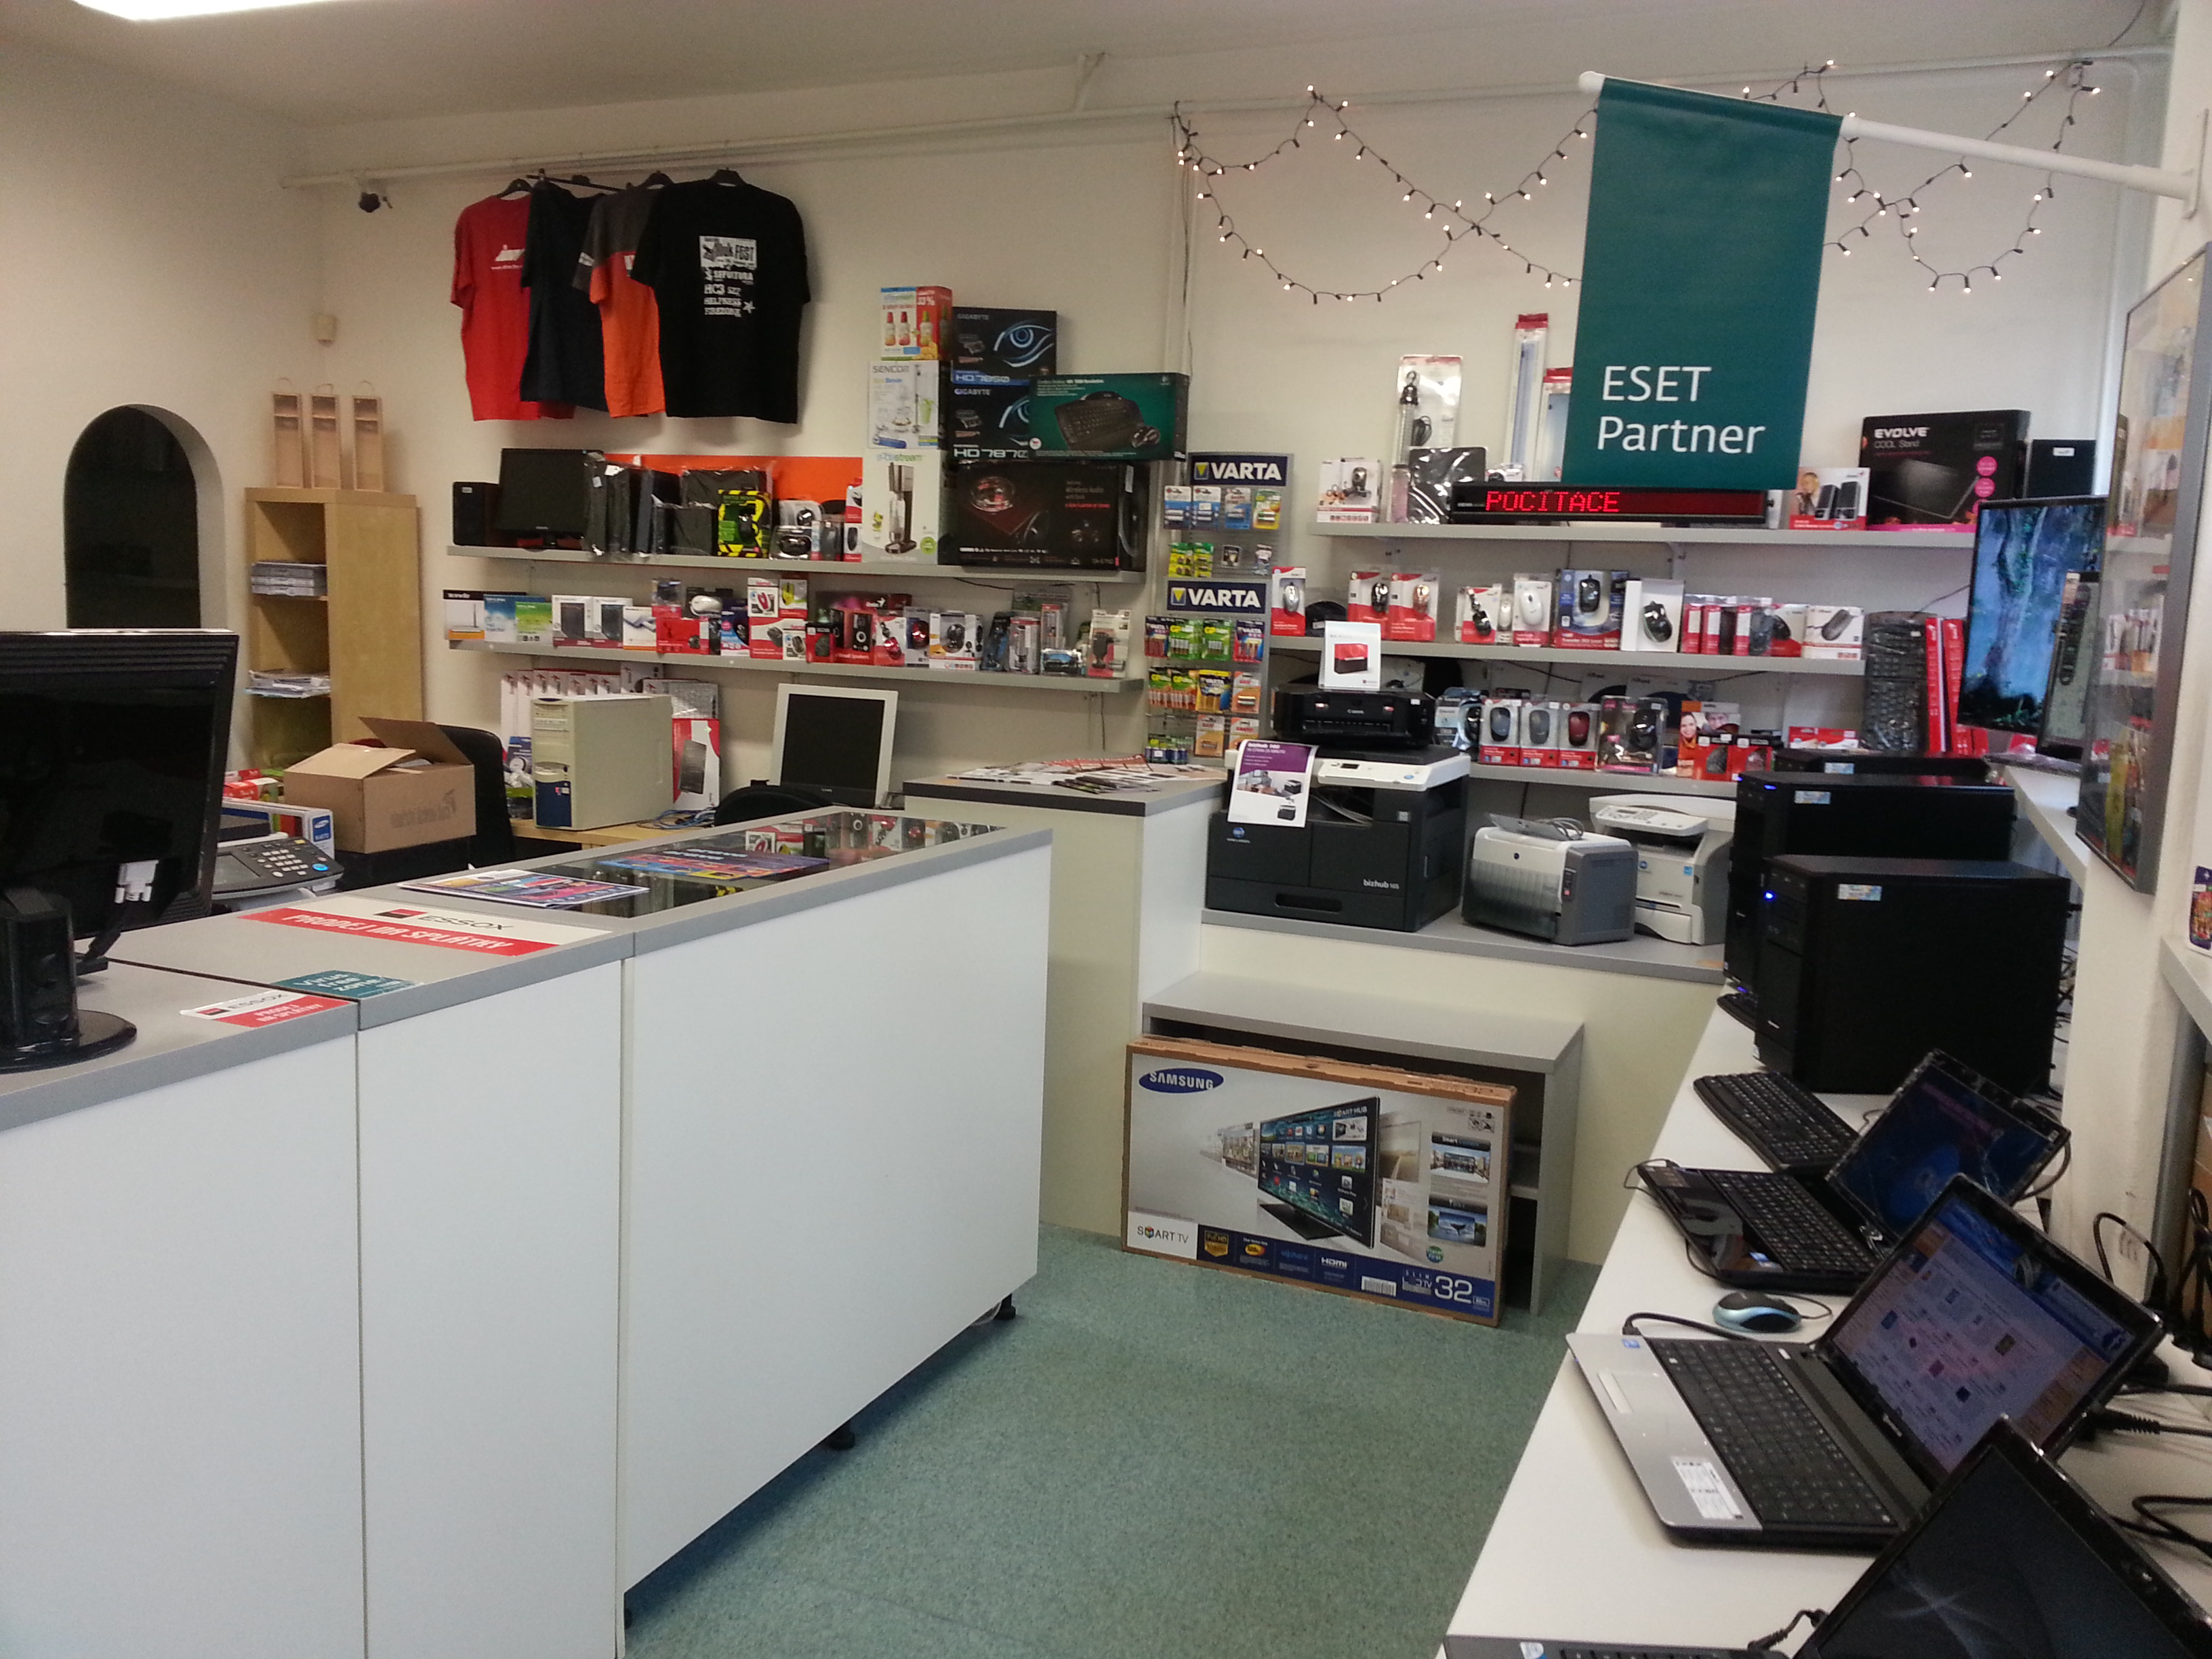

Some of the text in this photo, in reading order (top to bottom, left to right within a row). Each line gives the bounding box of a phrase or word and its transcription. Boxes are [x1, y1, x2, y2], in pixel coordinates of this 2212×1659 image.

[873, 365, 910, 373] SENCOR
[956, 374, 974, 382] HD
[1602, 365, 1712, 402] ESET
[954, 388, 991, 396] GIGABYTE
[1597, 415, 1766, 453] Partner
[1874, 427, 1928, 439] EVOLVE
[1898, 439, 1919, 448] Stand
[954, 449, 981, 458] HD
[1210, 462, 1282, 480] VARTA
[1486, 491, 1620, 512] POCITACE
[1188, 588, 1261, 608] VARTA
[1363, 879, 1389, 889] bizhub
[418, 916, 514, 930] ESSOX
[281, 914, 377, 931] PRODEJ
[401, 930, 514, 949] SPLÁTKY
[294, 973, 350, 987] Virus
[316, 977, 361, 988] free
[228, 994, 288, 1009] ESSOX
[1149, 1071, 1214, 1090] SAMSUNG
[1176, 1233, 1189, 1244] TV
[1321, 1256, 1347, 1267] HDMI
[1434, 1275, 1473, 1304] 32
